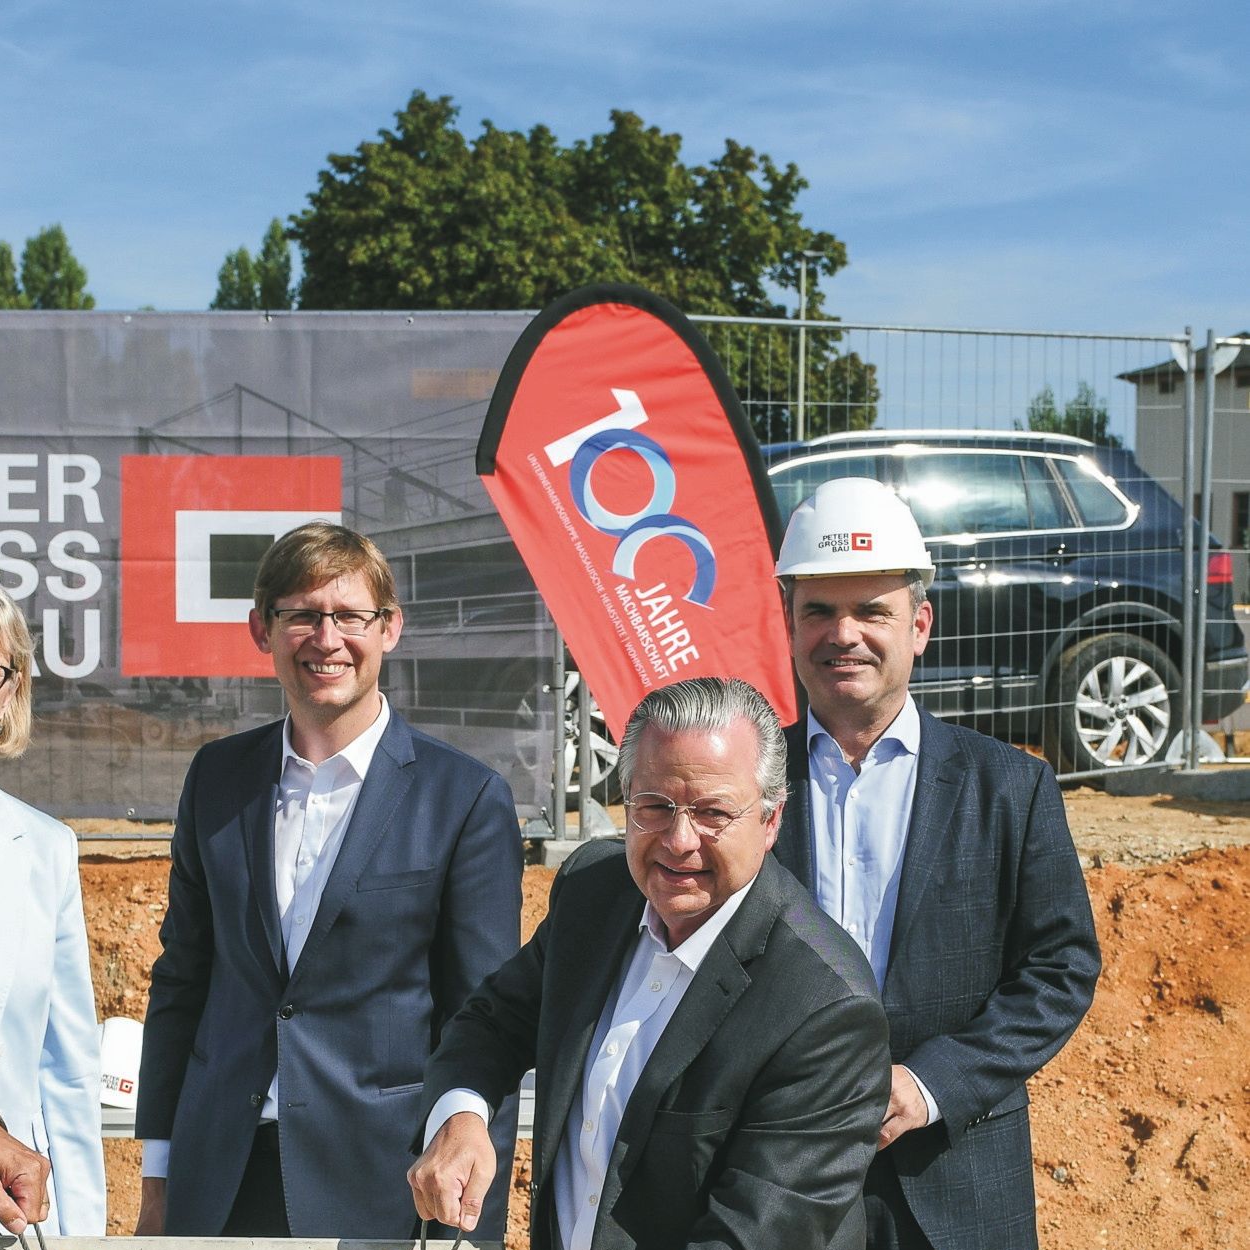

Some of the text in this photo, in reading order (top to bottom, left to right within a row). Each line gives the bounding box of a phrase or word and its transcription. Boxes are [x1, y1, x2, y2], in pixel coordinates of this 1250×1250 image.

[527, 453, 579, 542] UNTERNEHMENSGRUPPE
[822, 533, 849, 541] PETER
[818, 540, 849, 548] GROSS
[574, 541, 606, 593] NASSAUISCHE
[624, 641, 653, 689] WOHNSTADT
[614, 583, 671, 680] MACHBARSCHAFT
[634, 582, 700, 673] JAHRE
